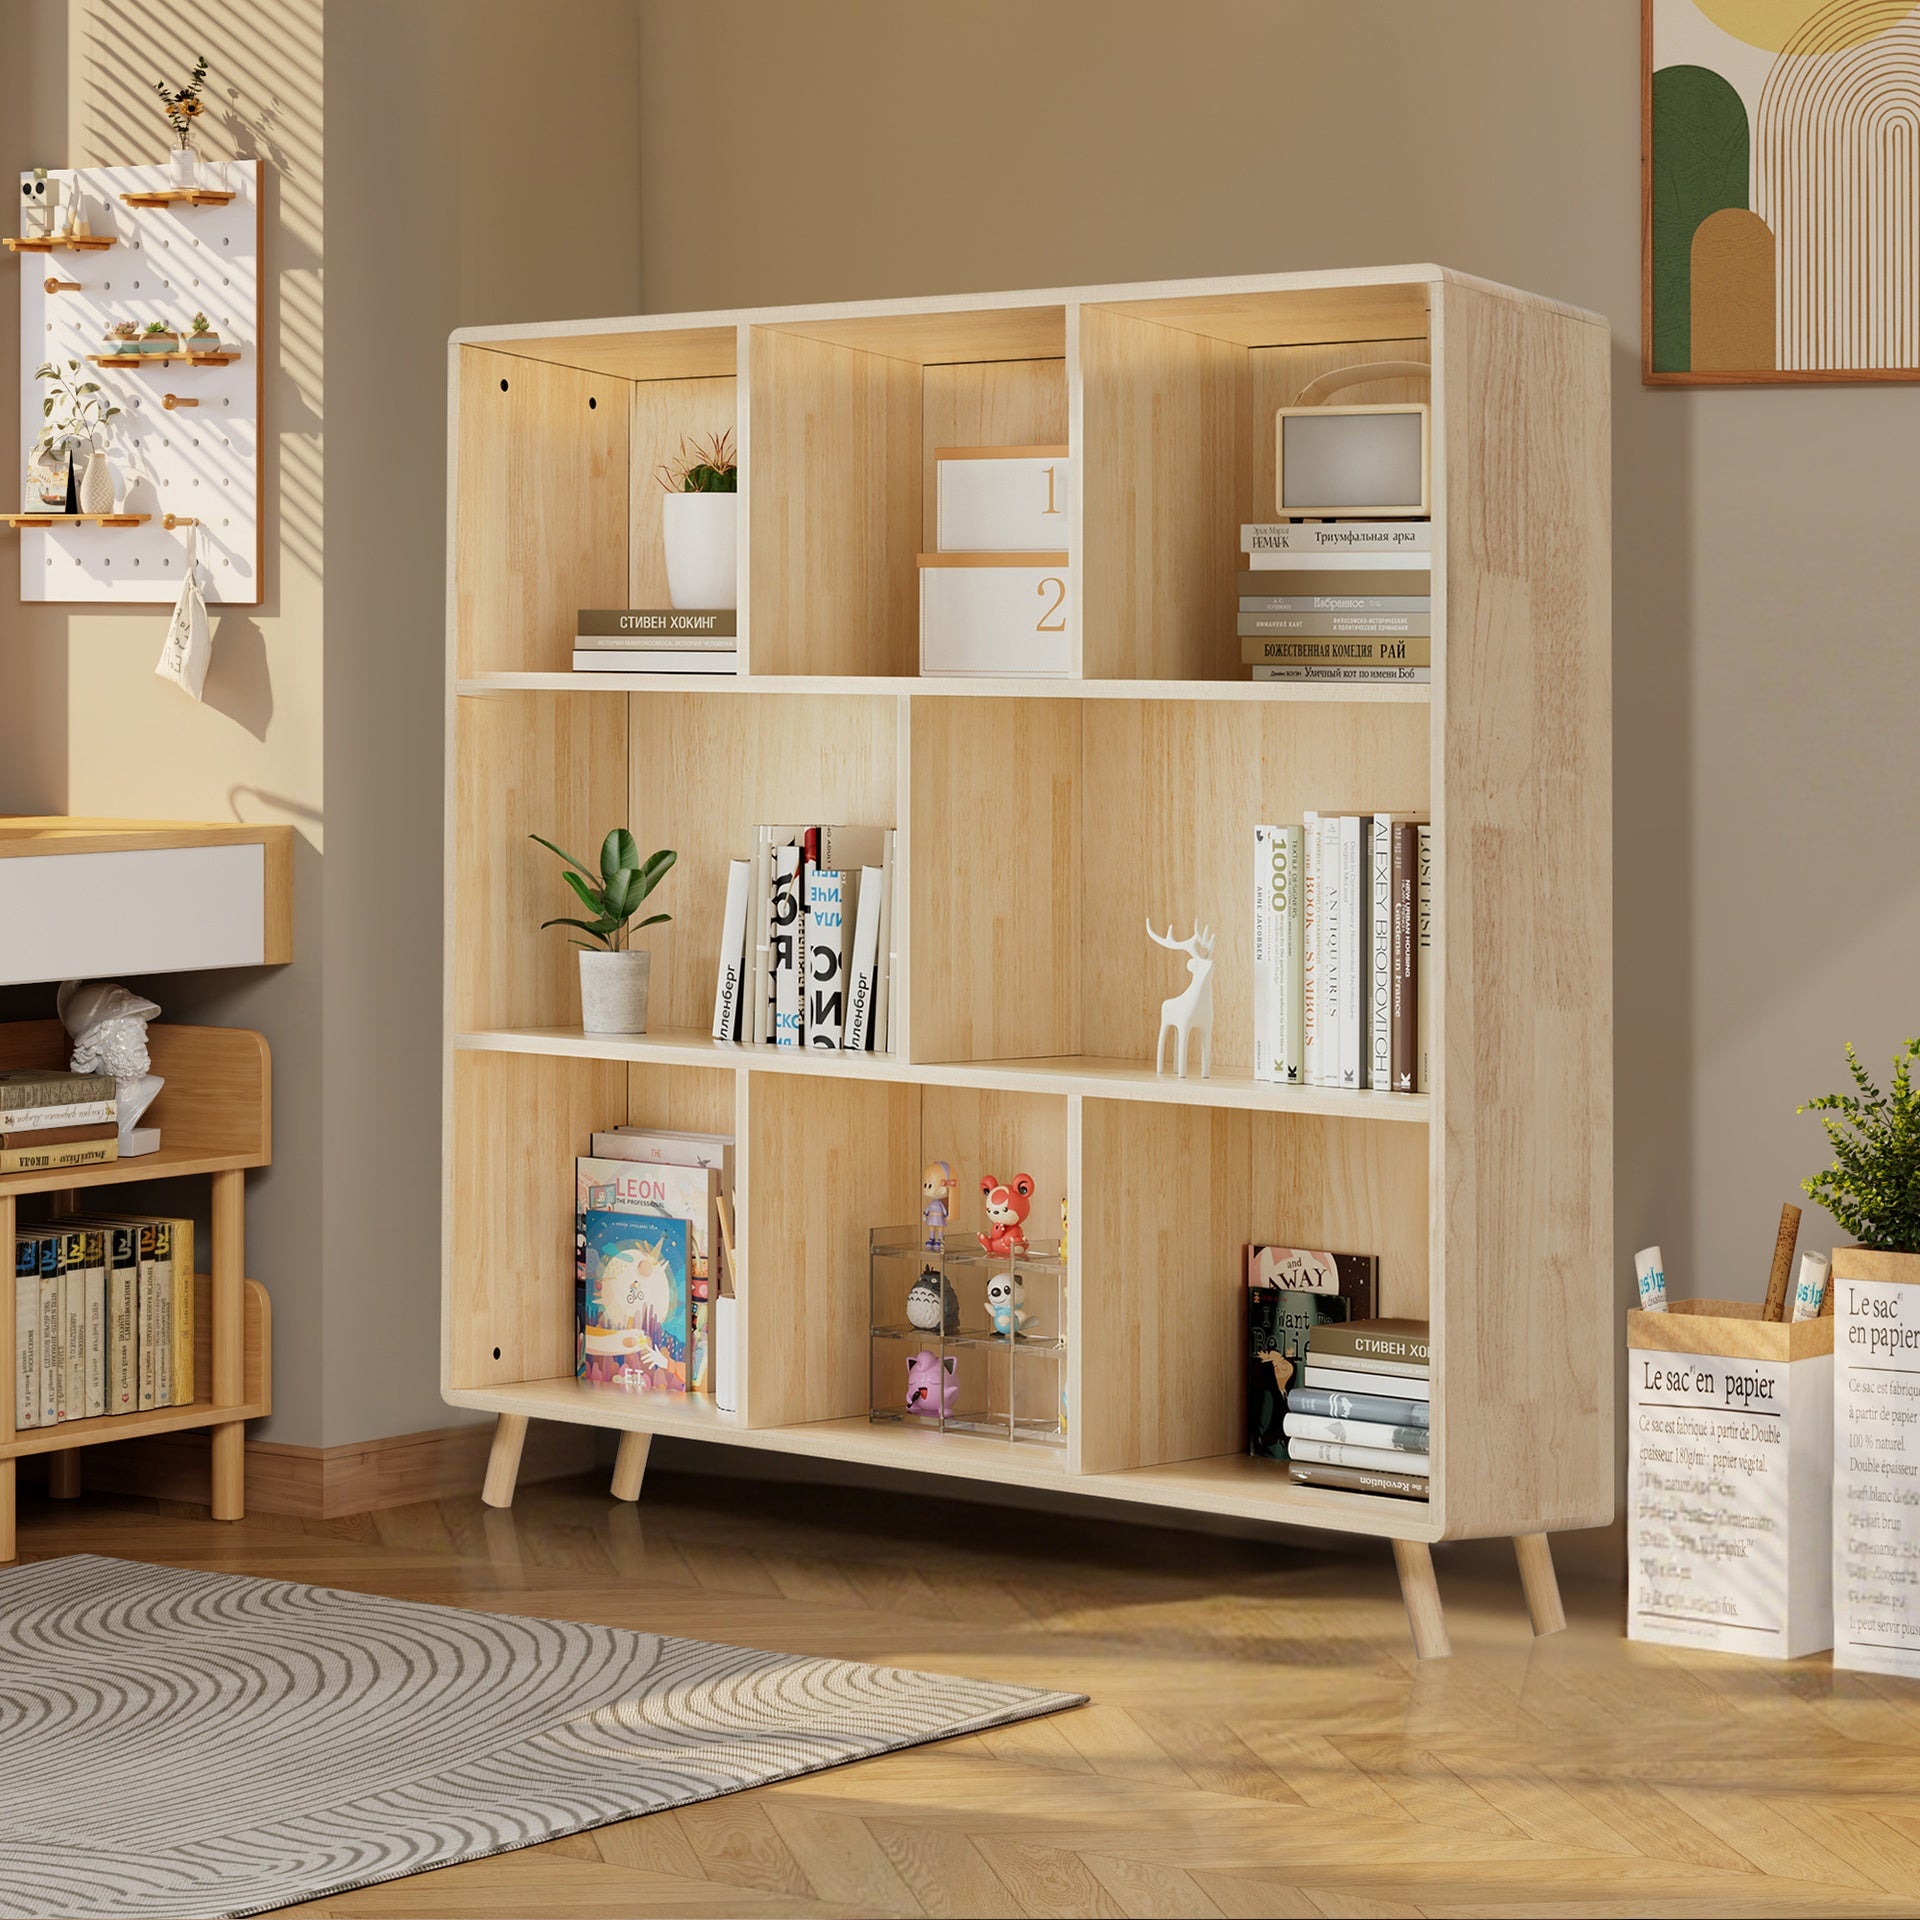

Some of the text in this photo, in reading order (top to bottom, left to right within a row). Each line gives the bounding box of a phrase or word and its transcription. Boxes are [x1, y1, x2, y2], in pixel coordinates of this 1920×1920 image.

[1041, 467, 1061, 514] 1
[1252, 536, 1290, 548] РЕМАРК
[1314, 530, 1416, 545] Триумфальная арка
[1036, 578, 1066, 632] 2
[620, 616, 717, 629] СТИВЕН ХОКИНГ
[1264, 640, 1406, 658] БОЖЕСТВЕННАЯ КОМЕДИЯ РАЙ
[1304, 666, 1415, 678] Уличный кот по имени Боб
[1272, 838, 1287, 912] 1000
[1376, 820, 1388, 912] ALEXEY
[1306, 876, 1314, 929] BOOK
[1328, 886, 1338, 1017] ANTIQUAIRES
[1395, 959, 1402, 970] in
[1306, 950, 1314, 1046] SYMBOLS
[1376, 920, 1388, 1072] BRODOVITCH
[19, 1155, 50, 1167] ШКОЛА
[650, 1148, 662, 1158] THE
[616, 1178, 665, 1200] LEON
[1286, 1256, 1302, 1269] and
[1268, 1268, 1327, 1290] AWAY
[1849, 1288, 1870, 1316] Le
[1276, 1309, 1311, 1330] Want
[1355, 1338, 1406, 1356] СТИВЕН
[1849, 1323, 1920, 1356] en papier
[1644, 1362, 1662, 1390] Le
[1696, 1372, 1714, 1393] en
[1724, 1368, 1775, 1406] papier
[1848, 1378, 1864, 1393] Ce
[1864, 1382, 1875, 1394] sac
[1876, 1383, 1888, 1394] est
[1848, 1405, 1918, 1426] à partir de papier
[1639, 1414, 1651, 1432] Ce
[1652, 1420, 1664, 1433] sac
[1664, 1421, 1675, 1434] est
[1676, 1416, 1708, 1442] fabriqué
[1717, 1422, 1738, 1444] partir
[1740, 1422, 1750, 1440] de
[1751, 1424, 1780, 1444] Double
[1639, 1442, 1674, 1466] épaisseur
[1712, 1450, 1738, 1473] papier
[1850, 1456, 1918, 1478] Double épaisseur
[1360, 1477, 1410, 1492] Revolution
